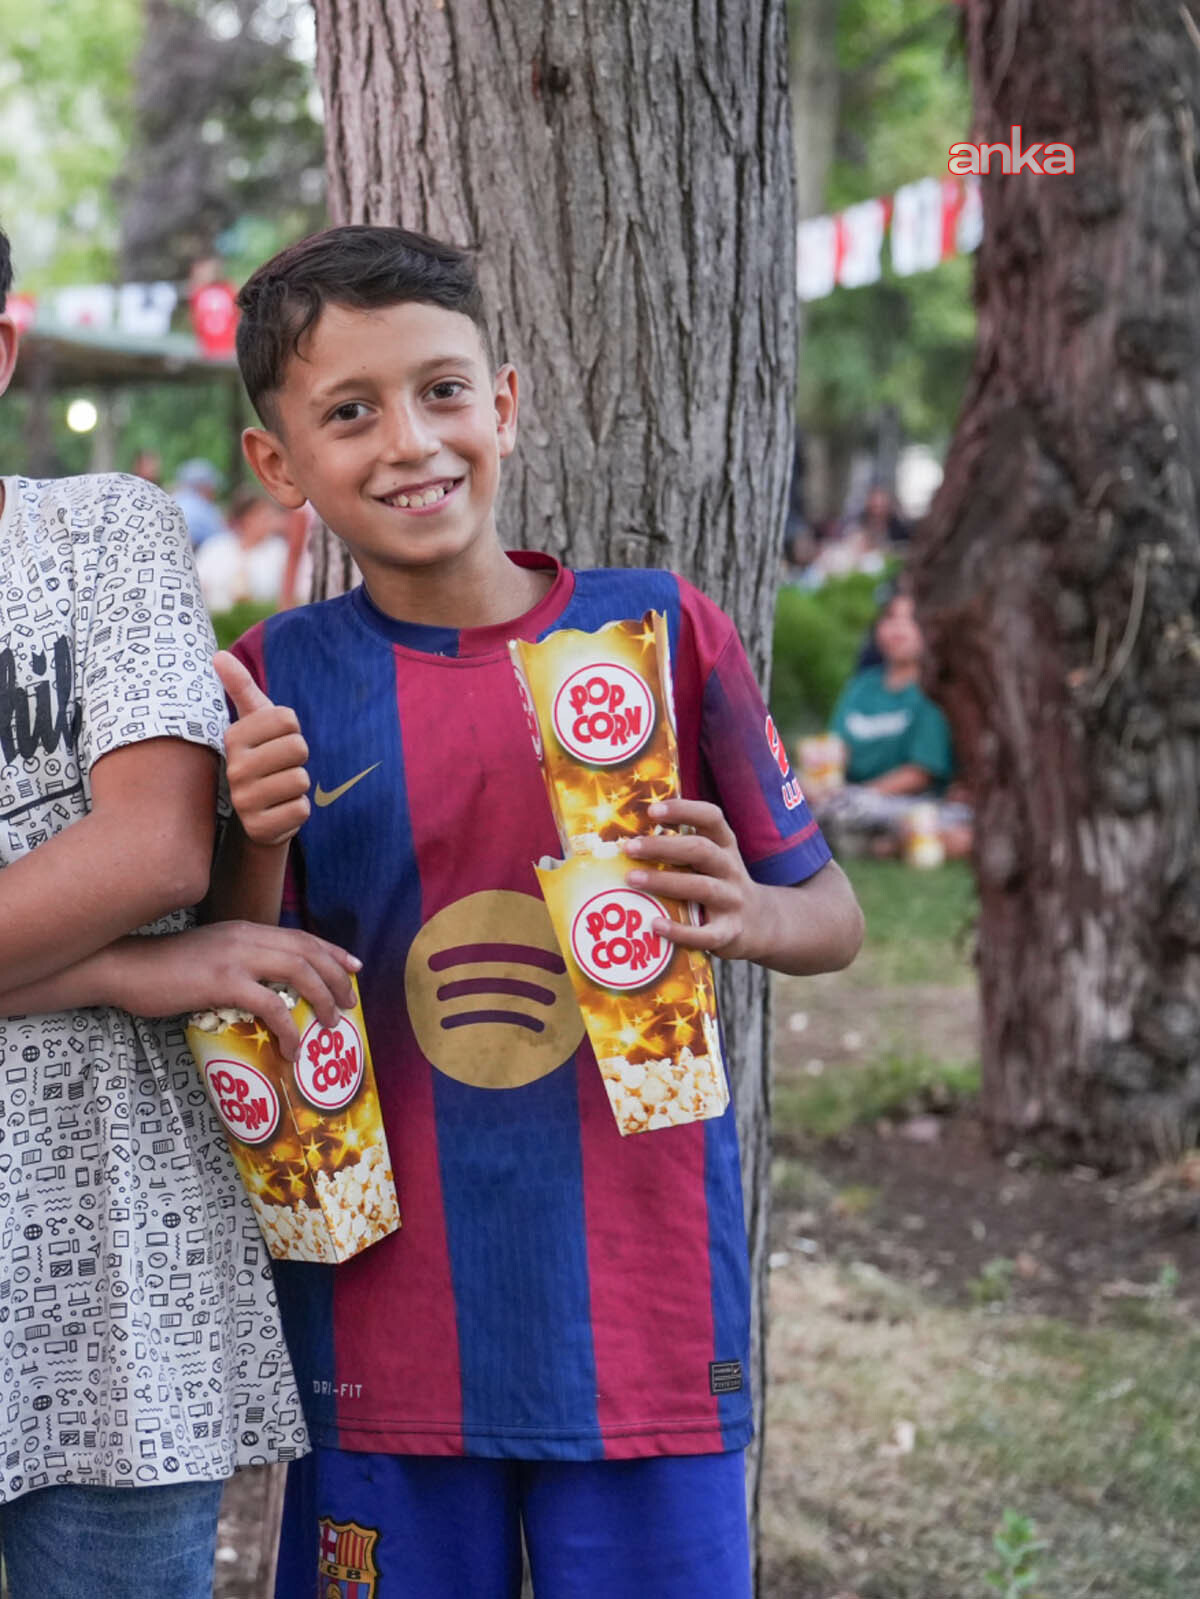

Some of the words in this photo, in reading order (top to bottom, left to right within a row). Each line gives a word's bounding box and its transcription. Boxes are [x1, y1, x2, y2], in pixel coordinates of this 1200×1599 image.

[568, 676, 625, 717] POP
[571, 705, 642, 747] CORN
[585, 902, 643, 941] POP
[590, 931, 662, 971] CORN
[306, 1027, 344, 1067] POP
[209, 1070, 250, 1101] POP
[311, 1046, 359, 1093] CORN
[219, 1098, 271, 1130] CORN
[312, 1380, 363, 1398] DRI-FIT
[321, 1562, 361, 1580] CB
